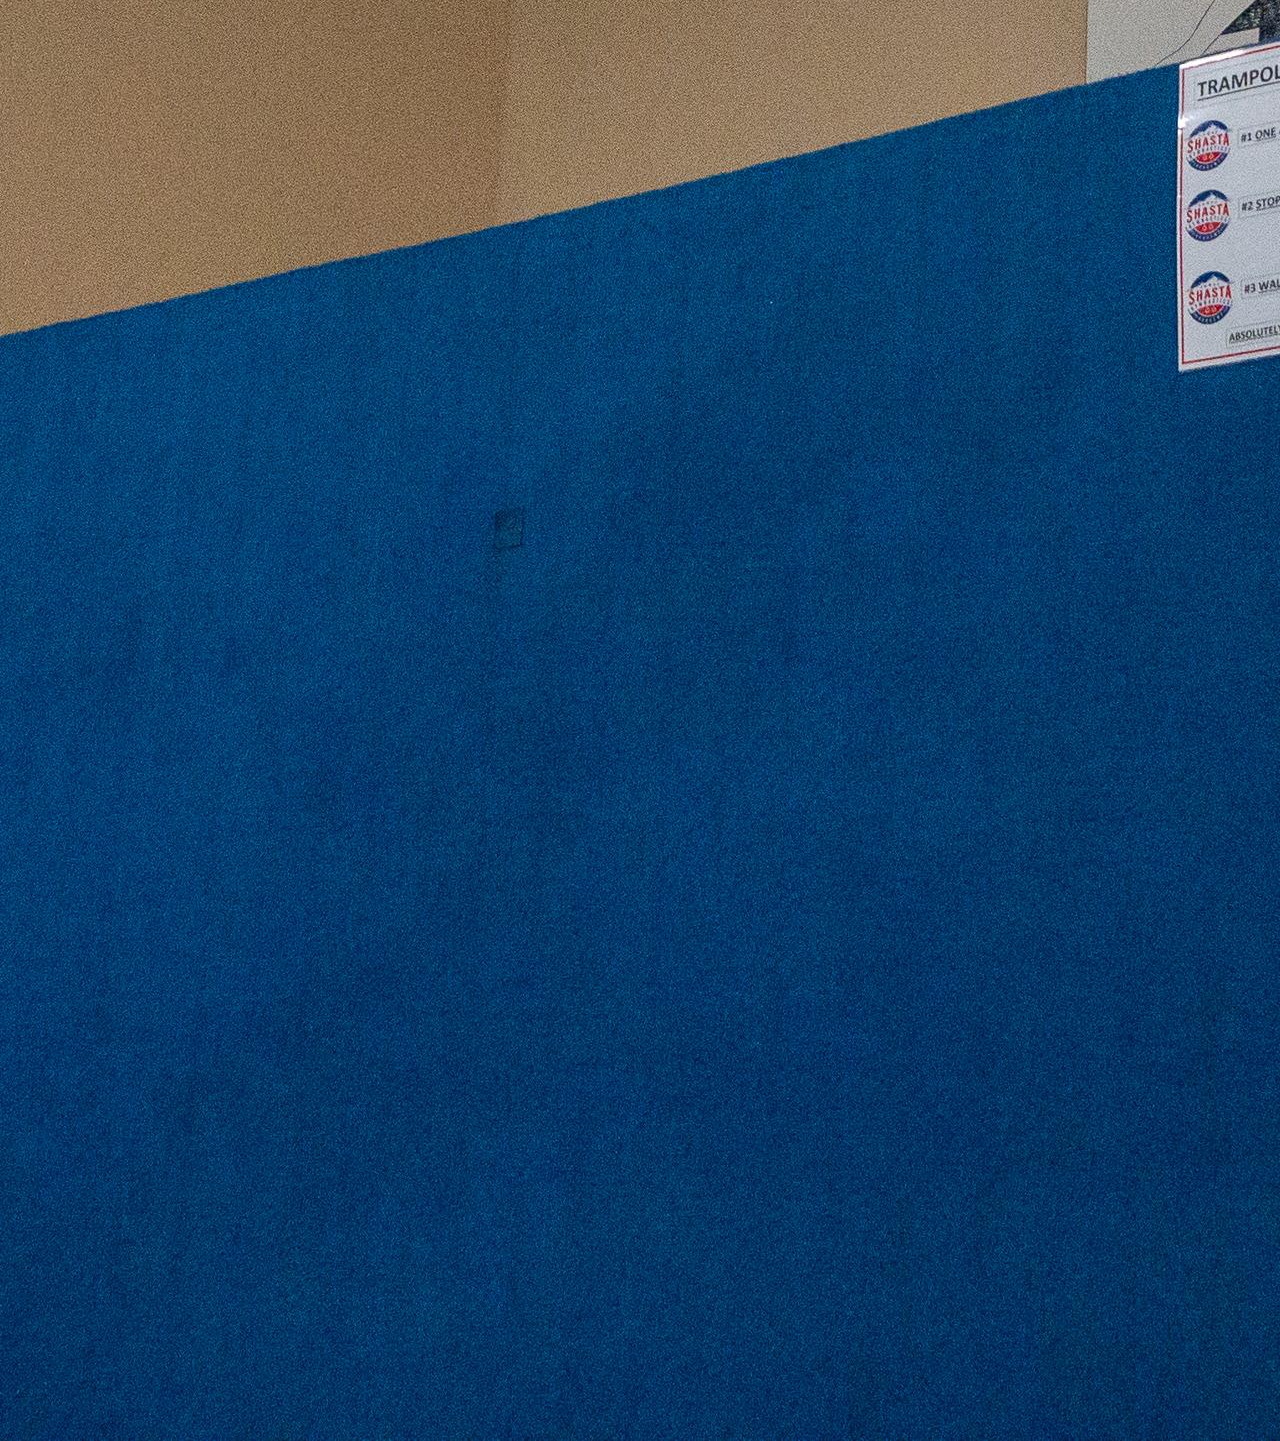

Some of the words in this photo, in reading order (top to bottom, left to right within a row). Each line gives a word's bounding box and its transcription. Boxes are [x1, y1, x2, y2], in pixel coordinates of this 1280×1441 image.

[1187, 133, 1229, 154] SHASTA
[1241, 133, 1252, 142] #1
[1255, 128, 1276, 140] ONE
[1242, 202, 1253, 211] #2
[1256, 196, 1280, 209] STOP
[1186, 202, 1229, 224] SHASTA
[1188, 285, 1232, 306] SHASTA
[1244, 283, 1256, 294] #3
